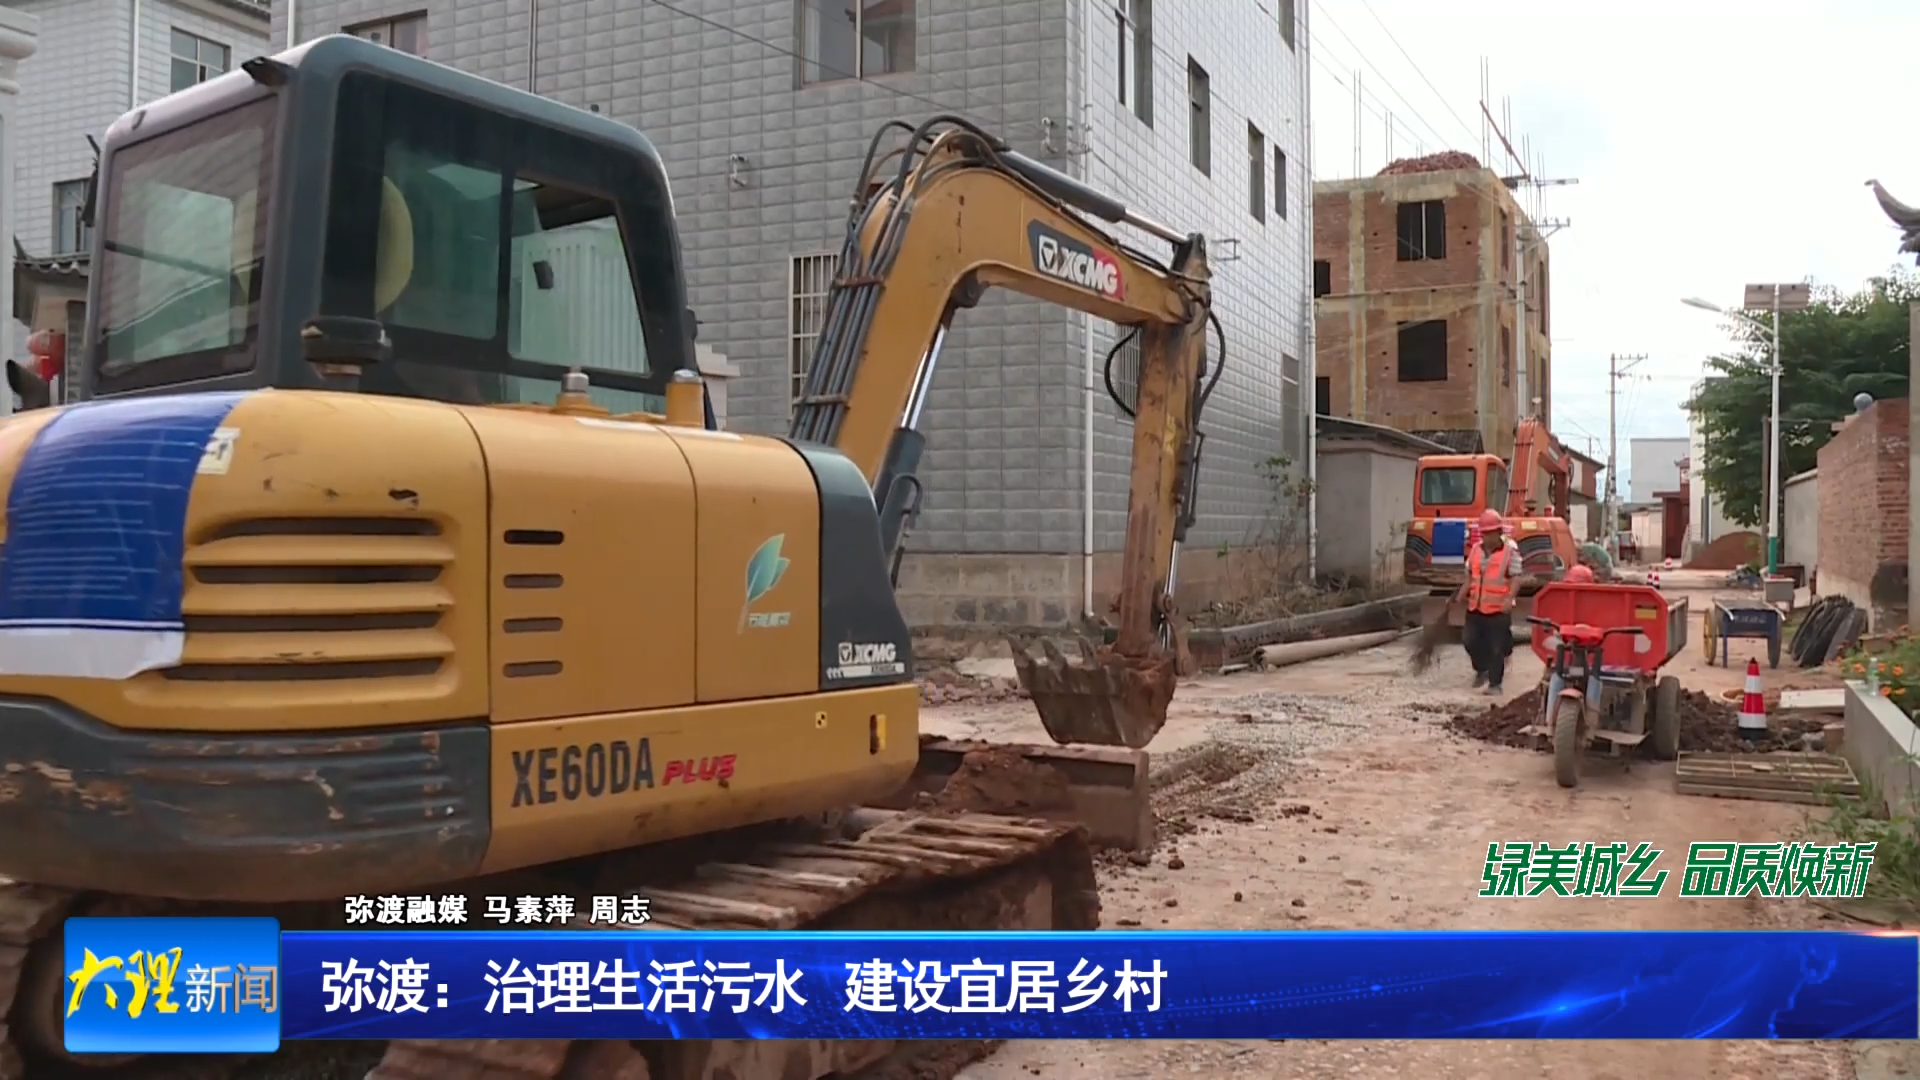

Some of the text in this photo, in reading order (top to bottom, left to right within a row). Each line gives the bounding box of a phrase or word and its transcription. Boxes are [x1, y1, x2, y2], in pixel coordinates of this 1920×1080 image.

[1058, 246, 1118, 295] XCMG
[853, 643, 897, 664] XCMG
[511, 737, 737, 807] XE60DA PLUS
